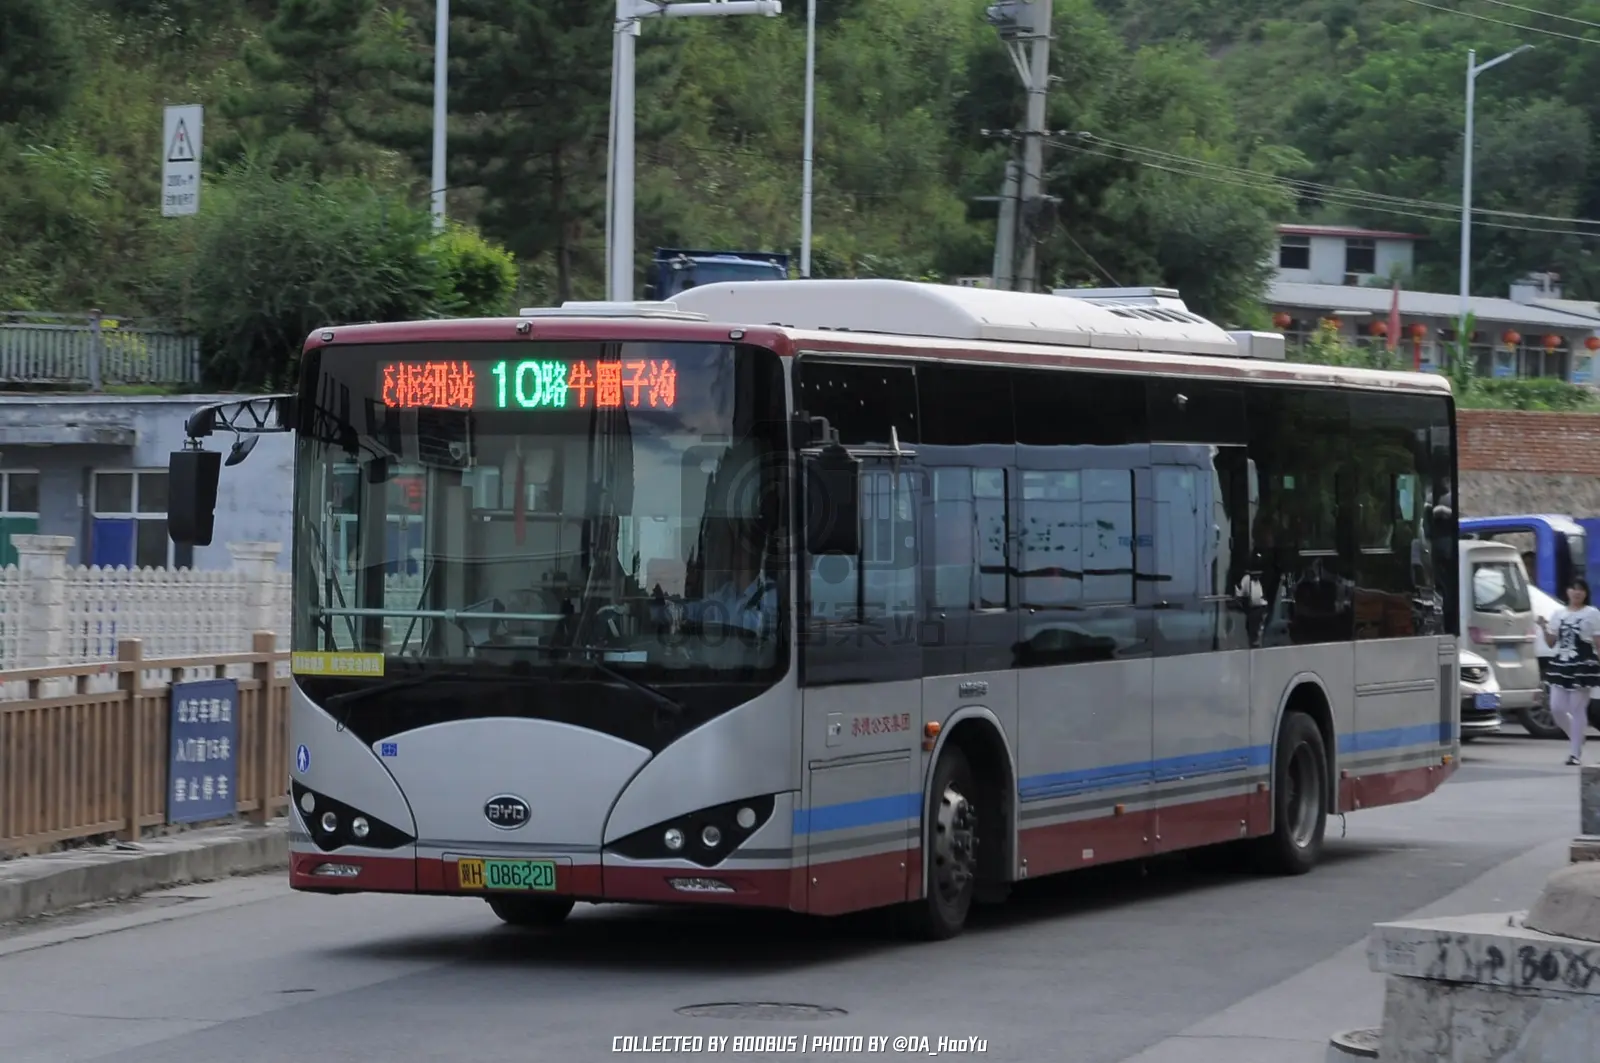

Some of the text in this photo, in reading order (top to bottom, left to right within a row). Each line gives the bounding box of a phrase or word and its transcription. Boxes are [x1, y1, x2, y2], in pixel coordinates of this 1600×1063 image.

[491, 360, 568, 408] 10路
[568, 360, 677, 408] 牛圈子沟
[488, 804, 525, 820] BYD
[490, 864, 554, 886] 08622D
